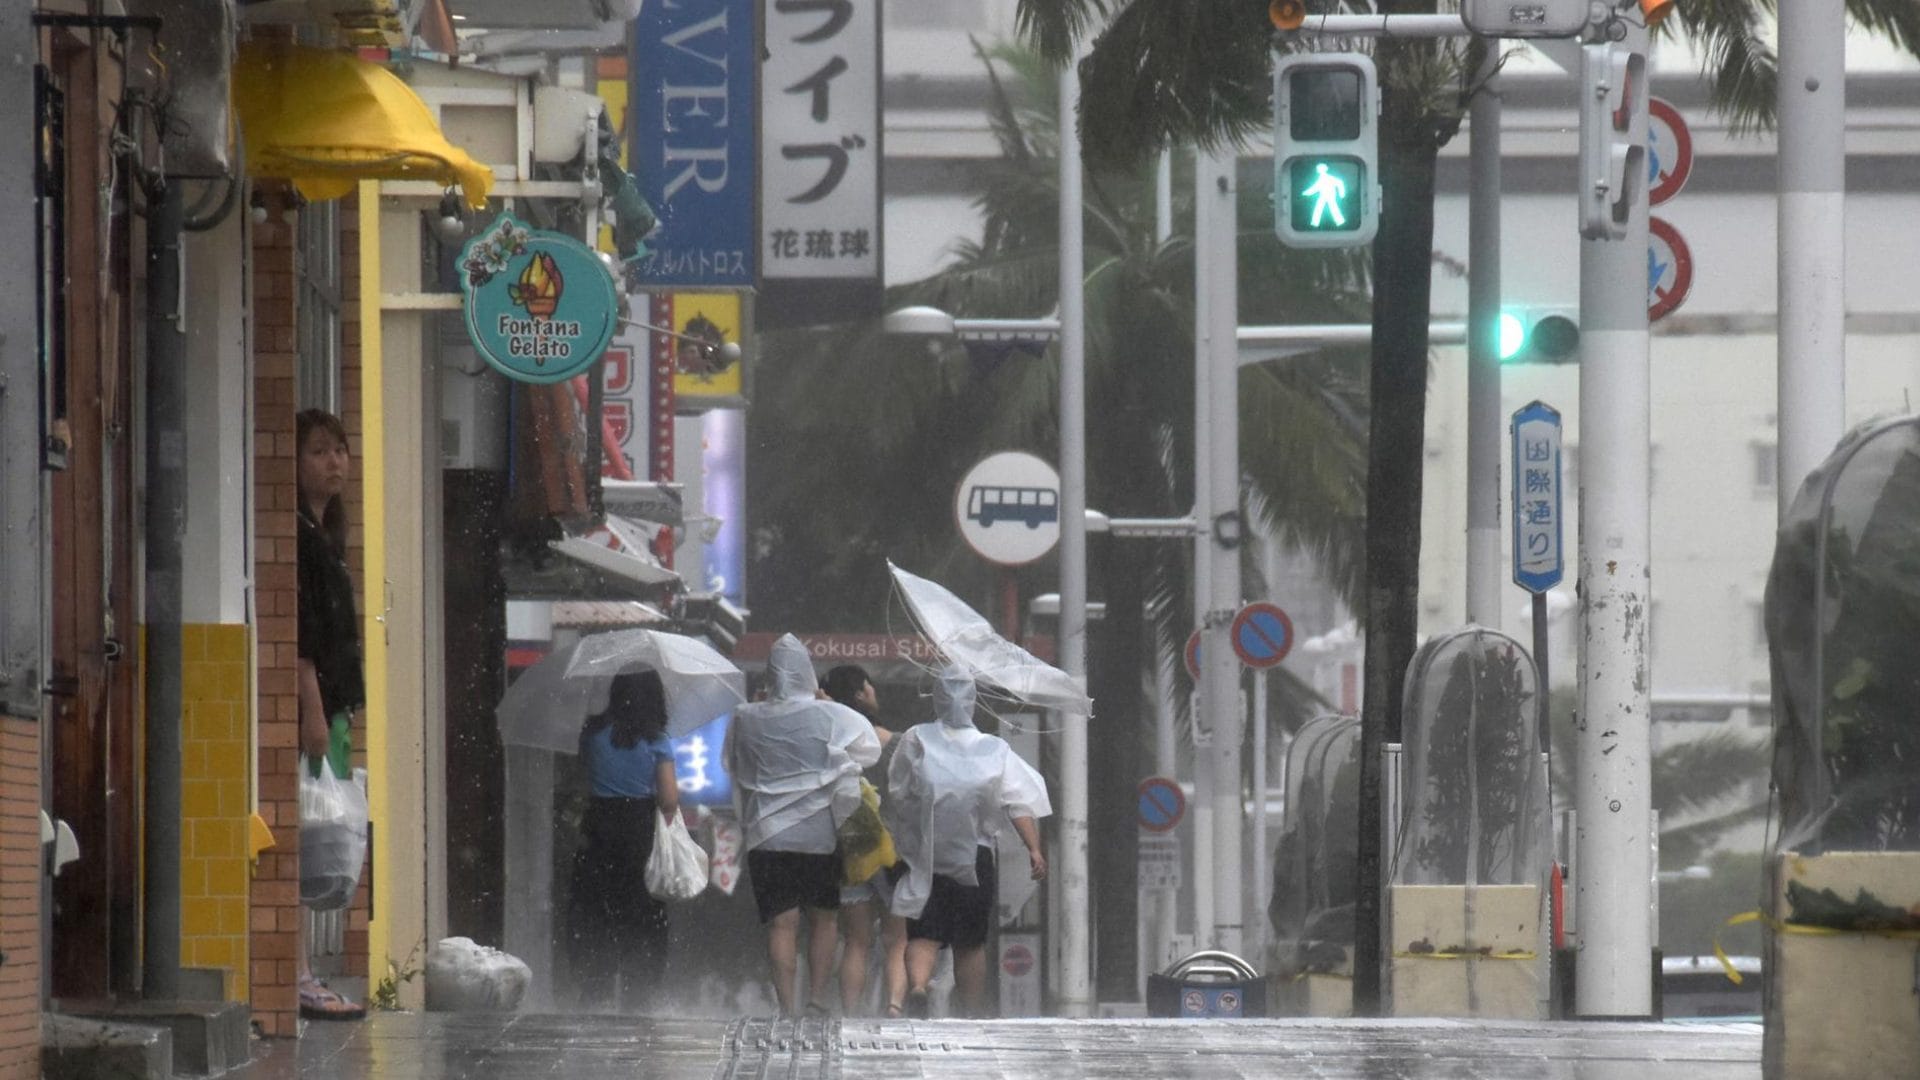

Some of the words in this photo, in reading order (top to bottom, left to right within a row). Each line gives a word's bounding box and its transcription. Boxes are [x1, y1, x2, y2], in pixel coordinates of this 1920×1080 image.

[660, 0, 729, 203] VER
[770, 229, 870, 259] 花琉球
[645, 247, 748, 277] アルバトロス
[498, 315, 580, 337] Fontana
[509, 336, 570, 357] Gelato
[1522, 439, 1553, 556] 国際通り
